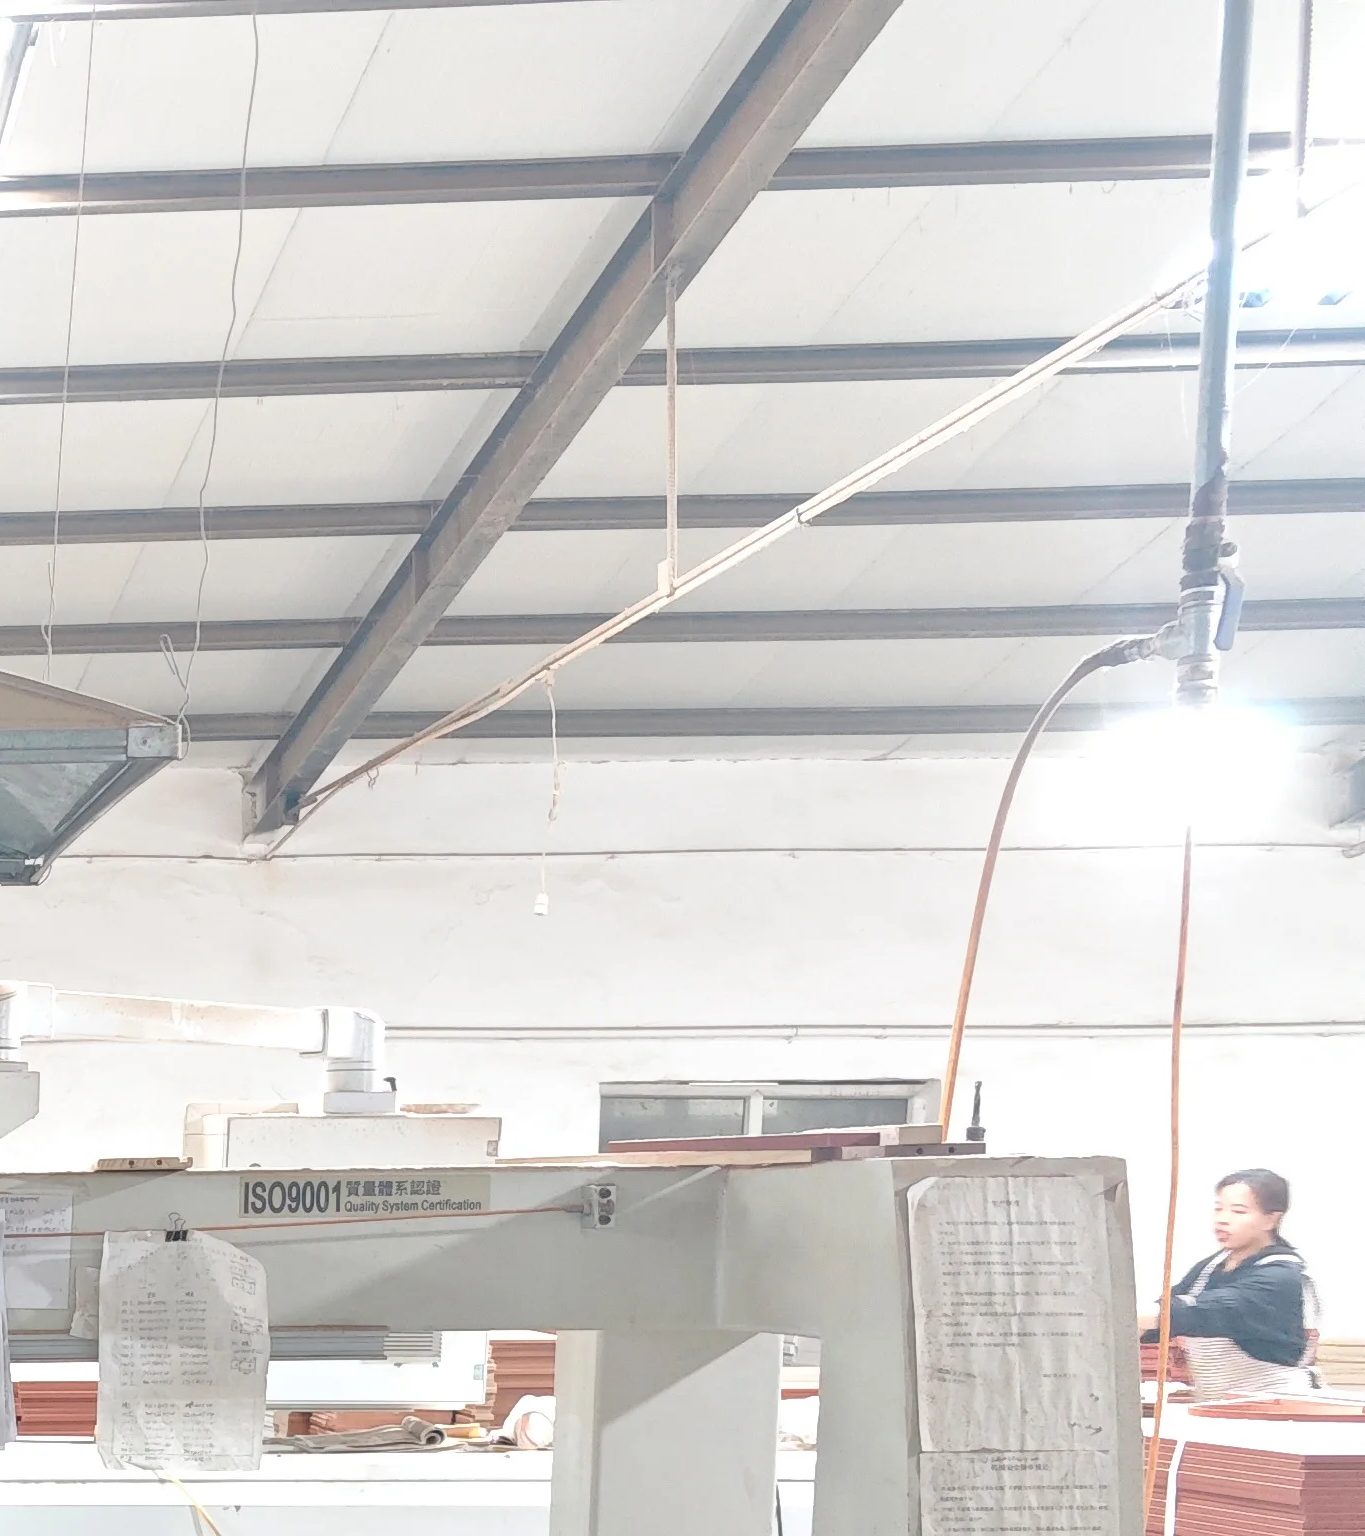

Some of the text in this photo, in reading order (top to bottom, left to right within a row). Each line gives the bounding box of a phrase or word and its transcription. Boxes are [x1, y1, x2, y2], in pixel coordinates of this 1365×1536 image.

[243, 1180, 342, 1214] ISO9001
[345, 1179, 442, 1198] 質量體系認證
[344, 1198, 482, 1214] Quality System Certification
